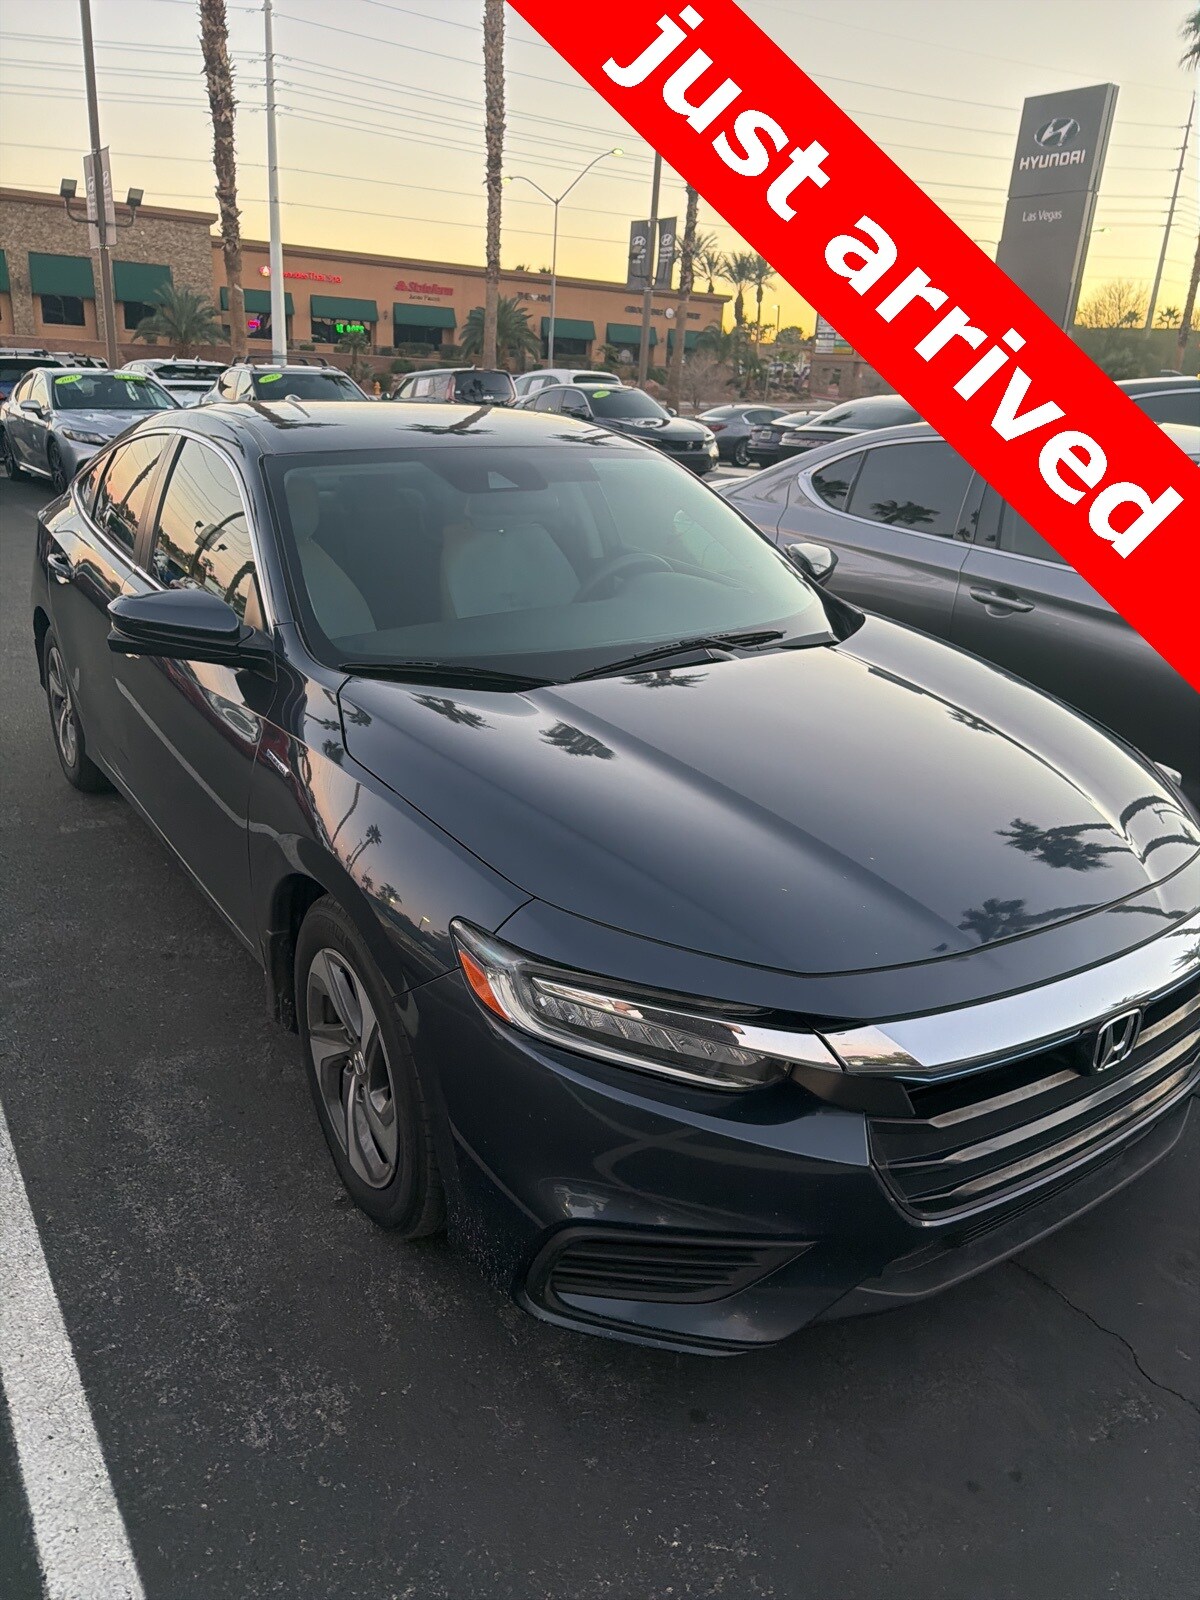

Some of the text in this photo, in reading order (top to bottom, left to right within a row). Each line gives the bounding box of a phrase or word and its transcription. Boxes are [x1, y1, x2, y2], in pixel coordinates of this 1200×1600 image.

[1019, 148, 1086, 171] HYUNDAI
[1022, 209, 1063, 223] Las Vegas
